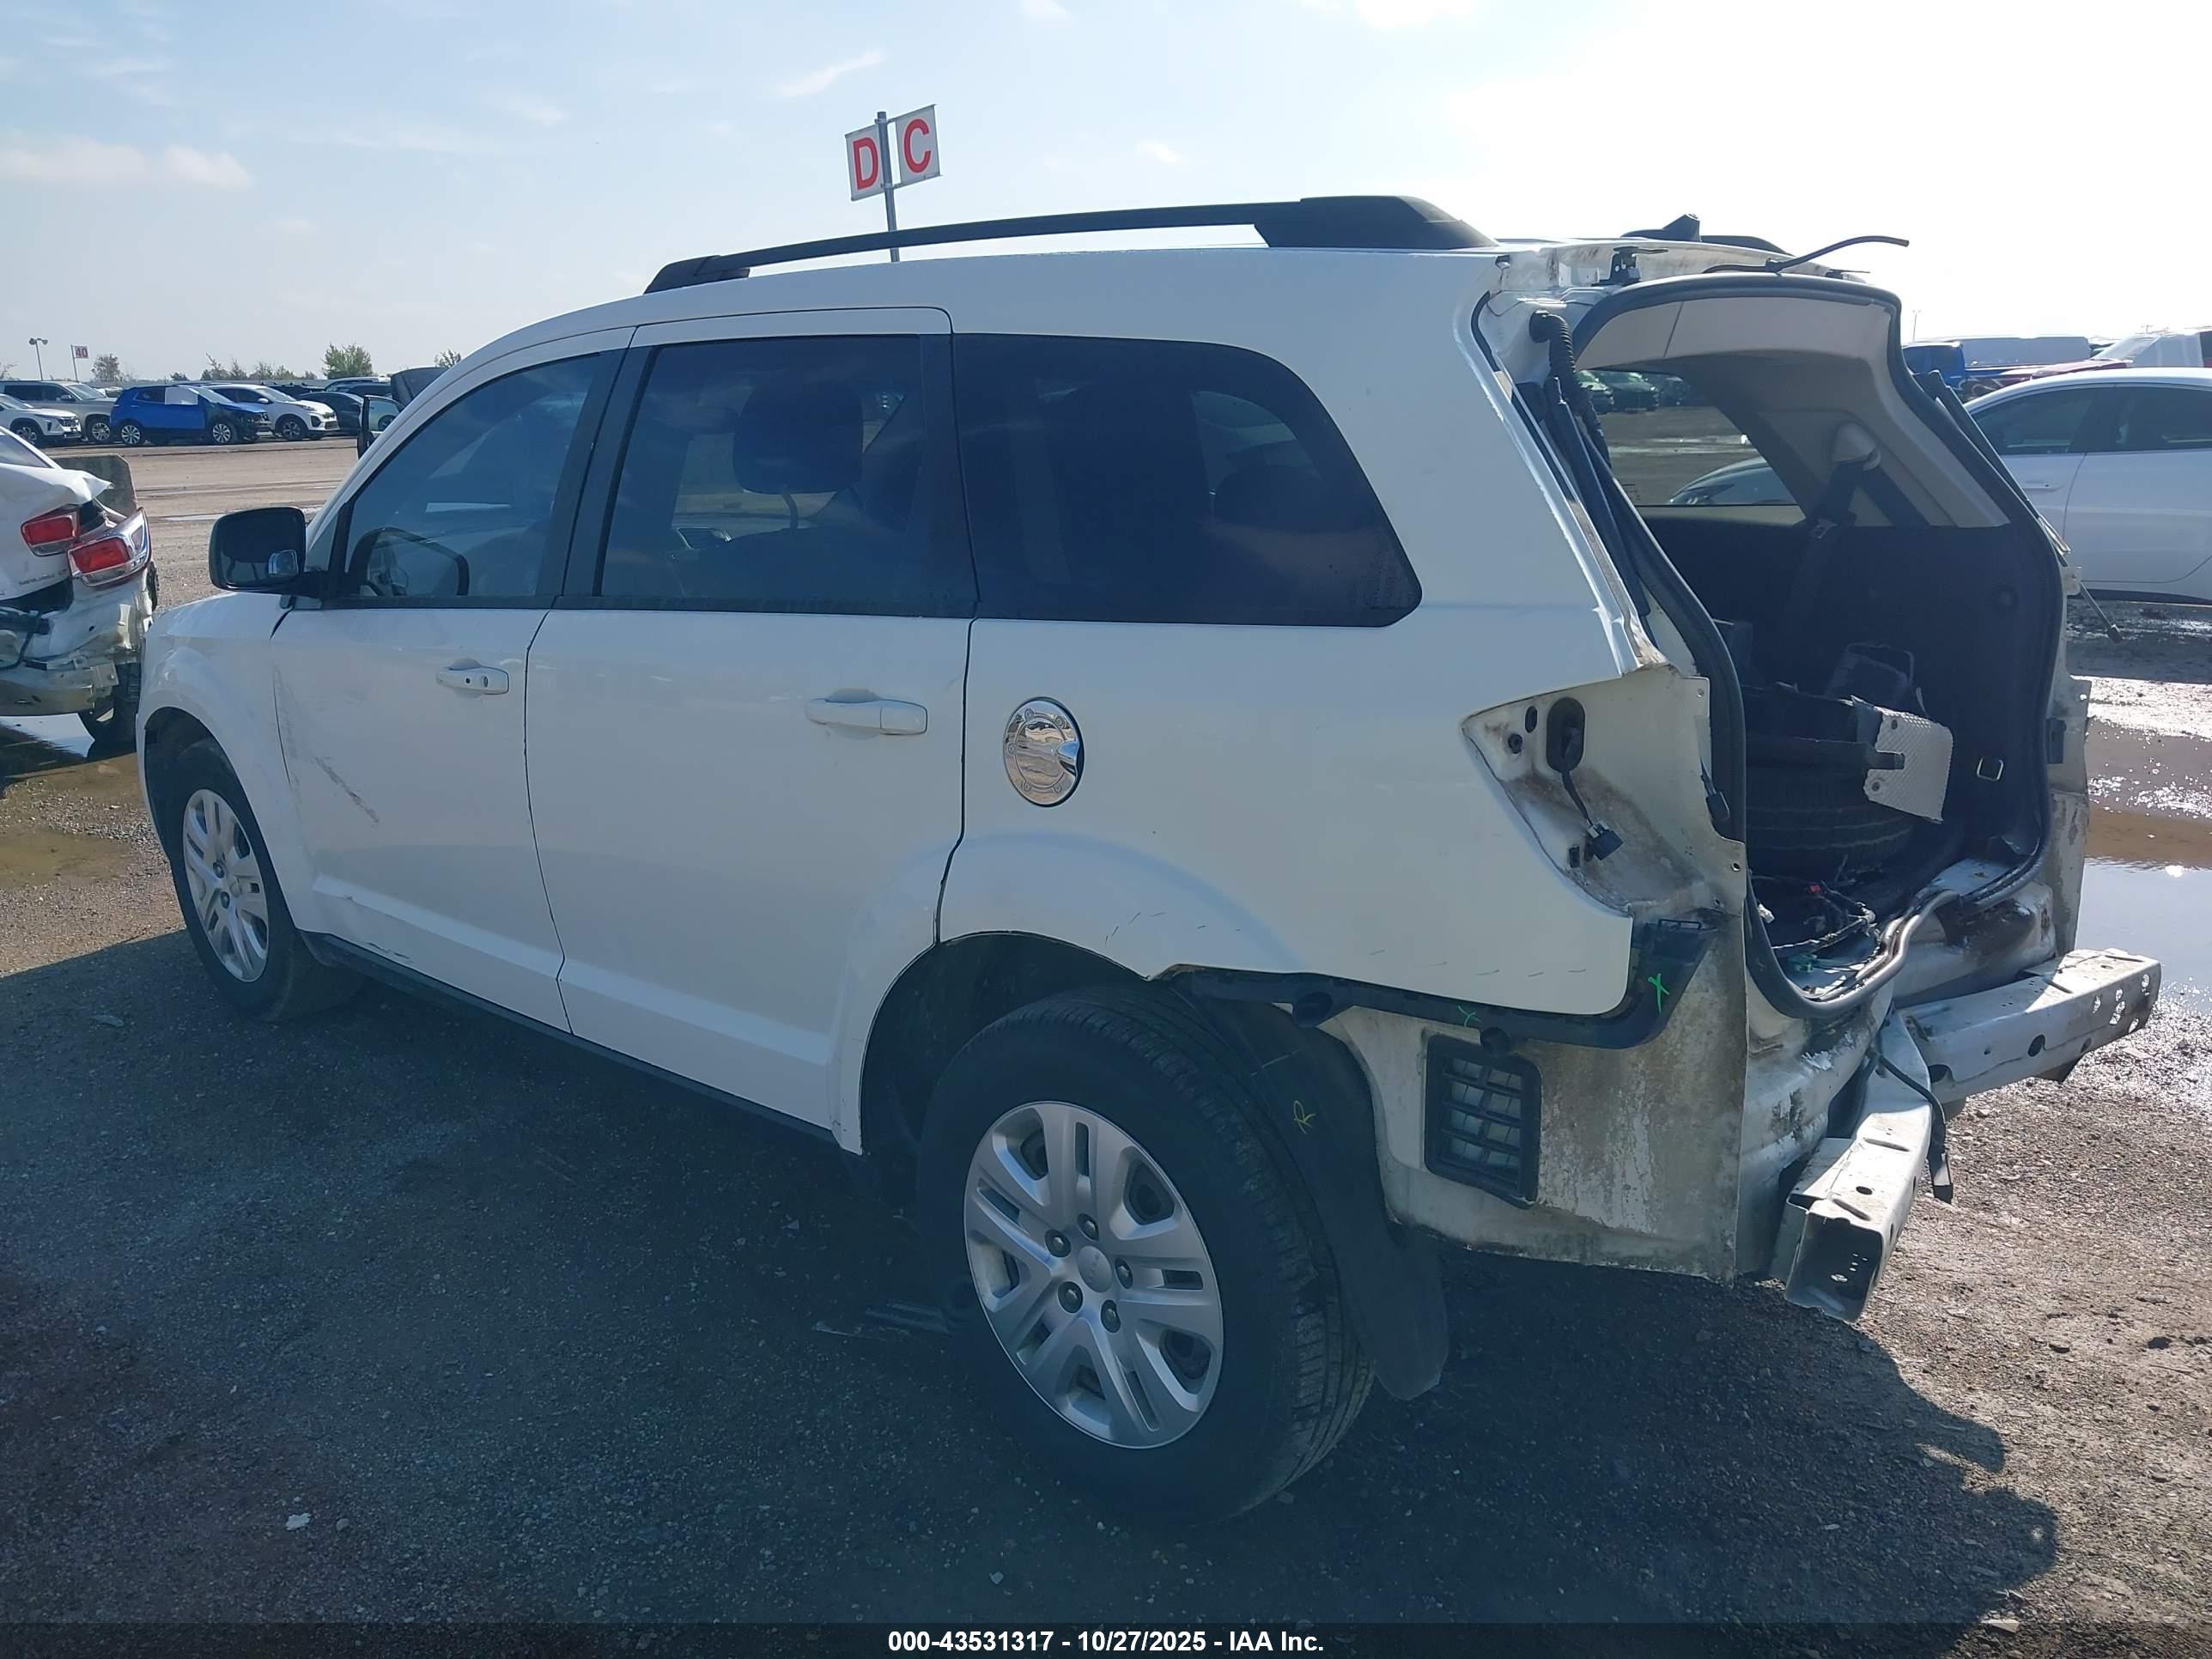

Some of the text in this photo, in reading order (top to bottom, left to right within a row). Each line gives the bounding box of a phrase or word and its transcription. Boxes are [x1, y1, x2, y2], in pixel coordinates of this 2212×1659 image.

[853, 137, 878, 191] D
[903, 118, 932, 173] C
[76, 347, 88, 358] 40
